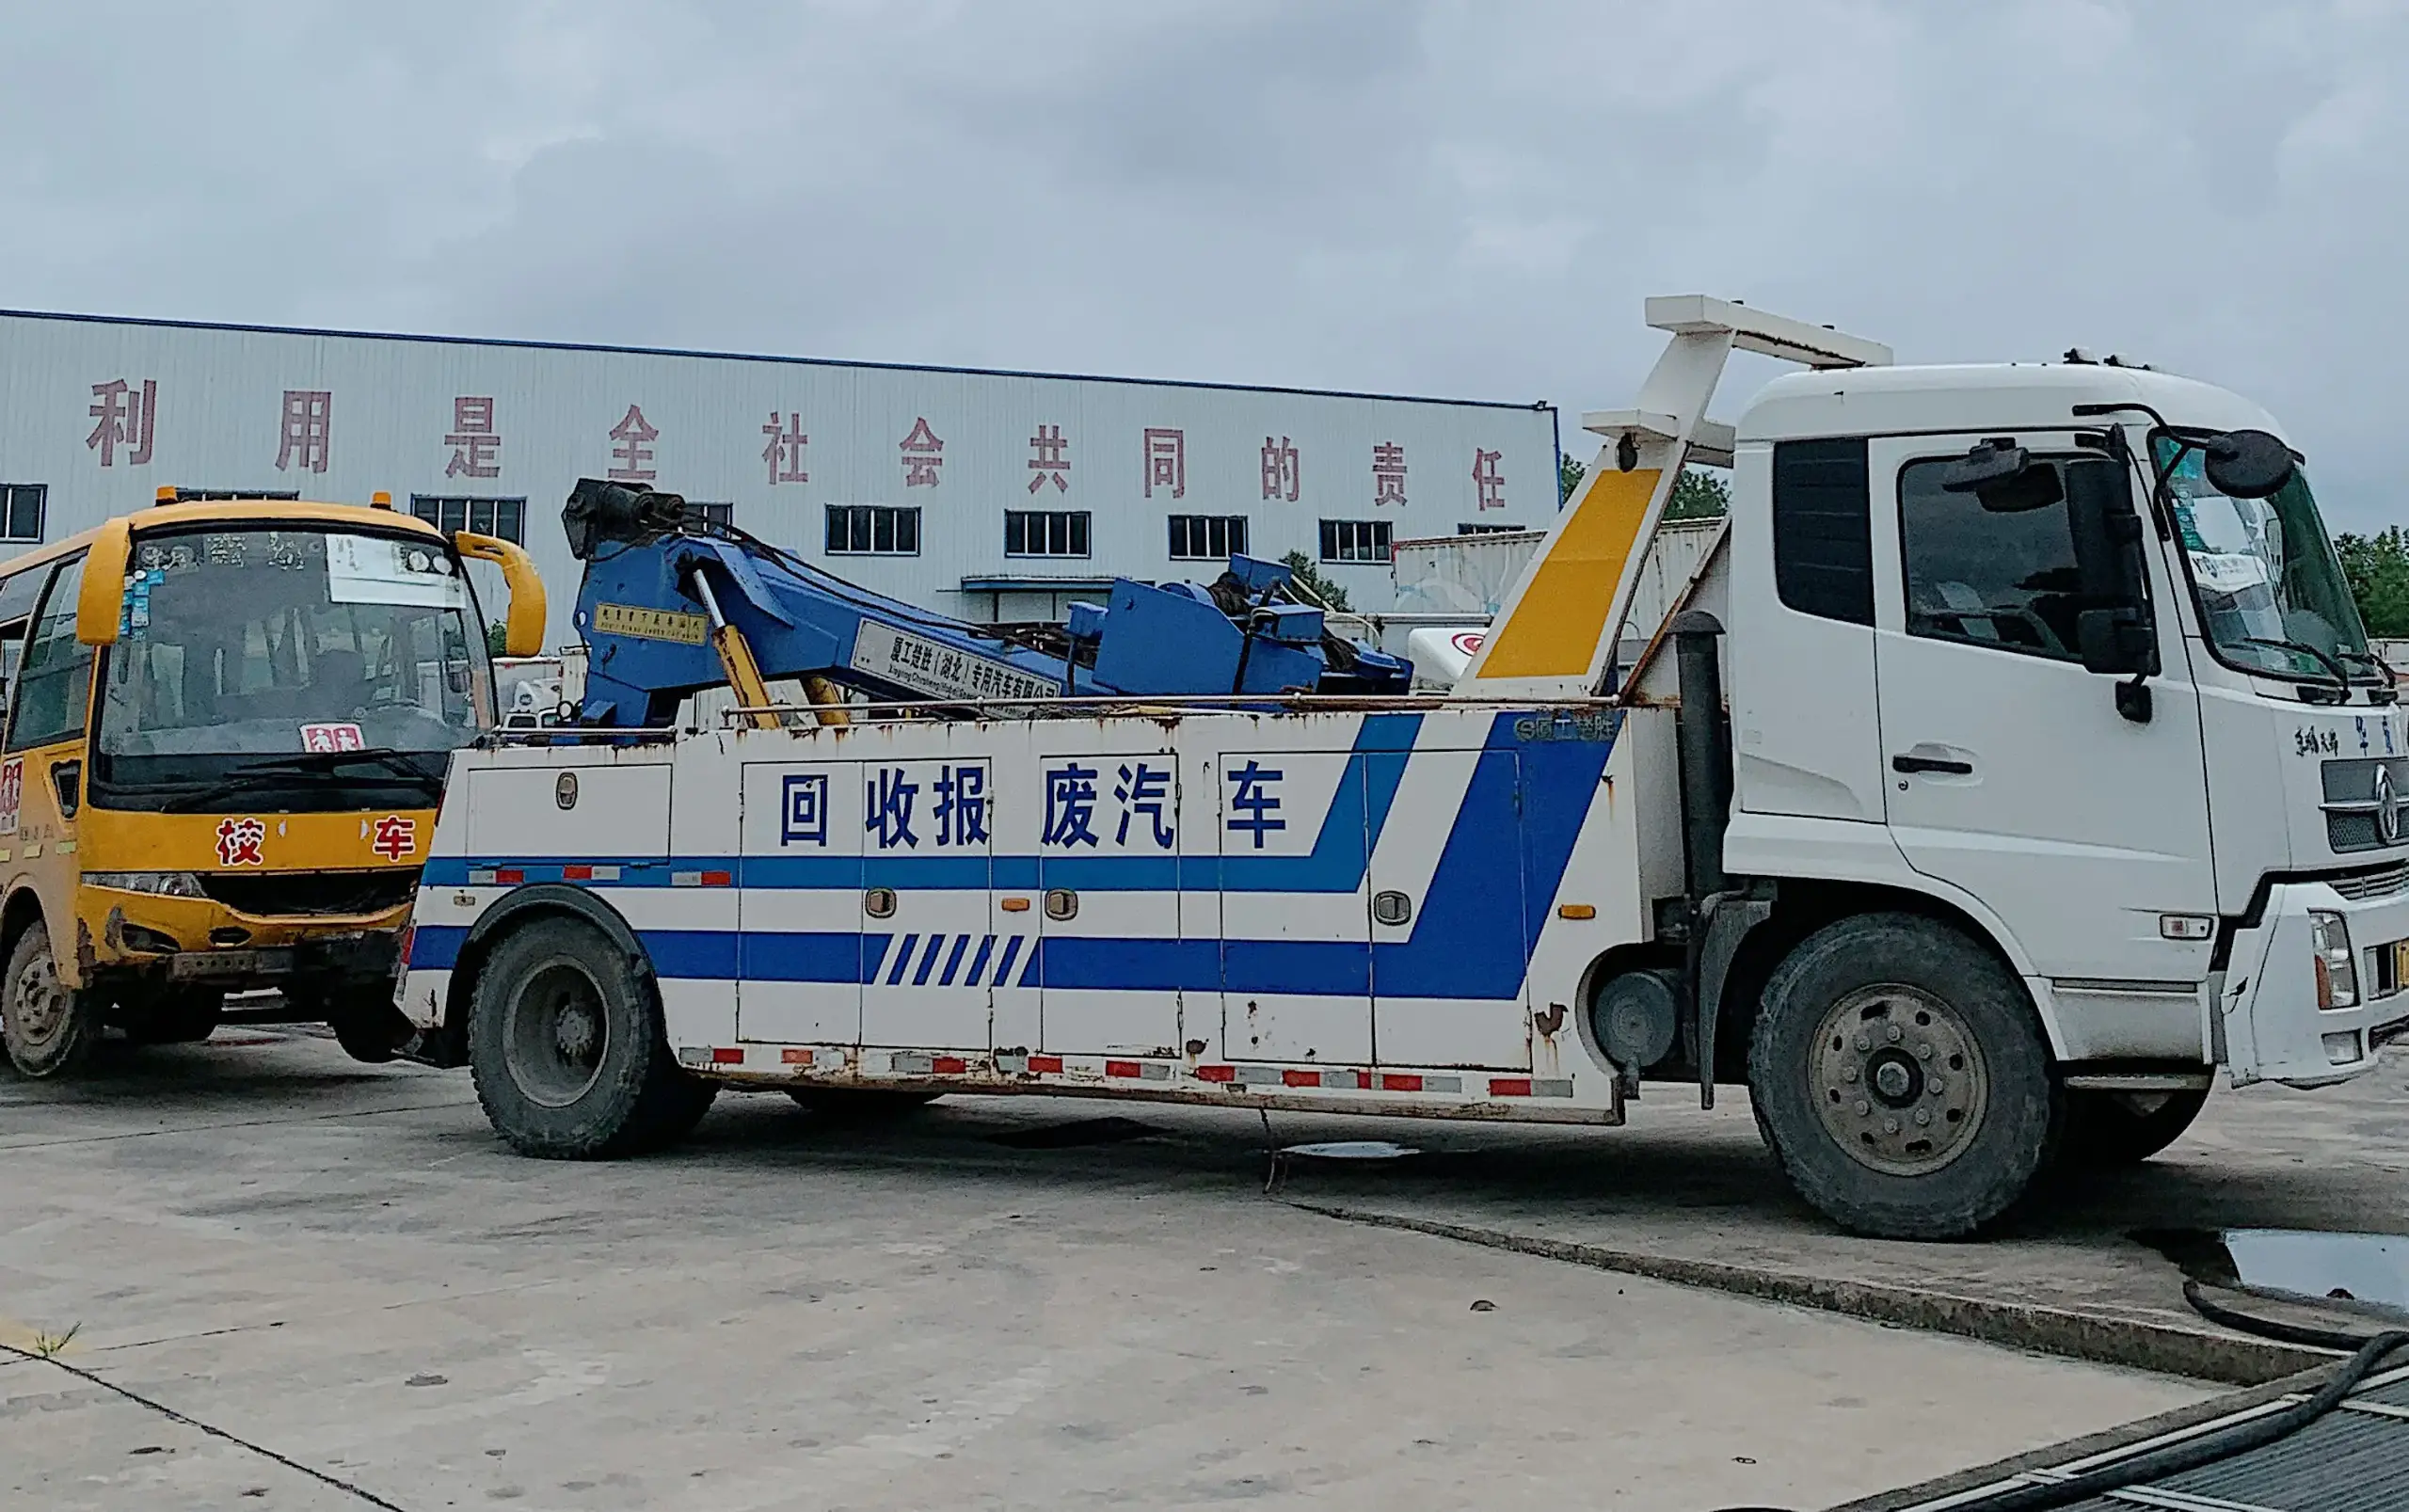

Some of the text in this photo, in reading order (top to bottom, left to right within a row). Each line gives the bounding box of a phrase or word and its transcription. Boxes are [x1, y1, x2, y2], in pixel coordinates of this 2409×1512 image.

[86, 377, 1508, 511] 利用是全社会共同的责任
[215, 815, 416, 867] 校车
[780, 759, 1287, 851] 回收报废汽车
